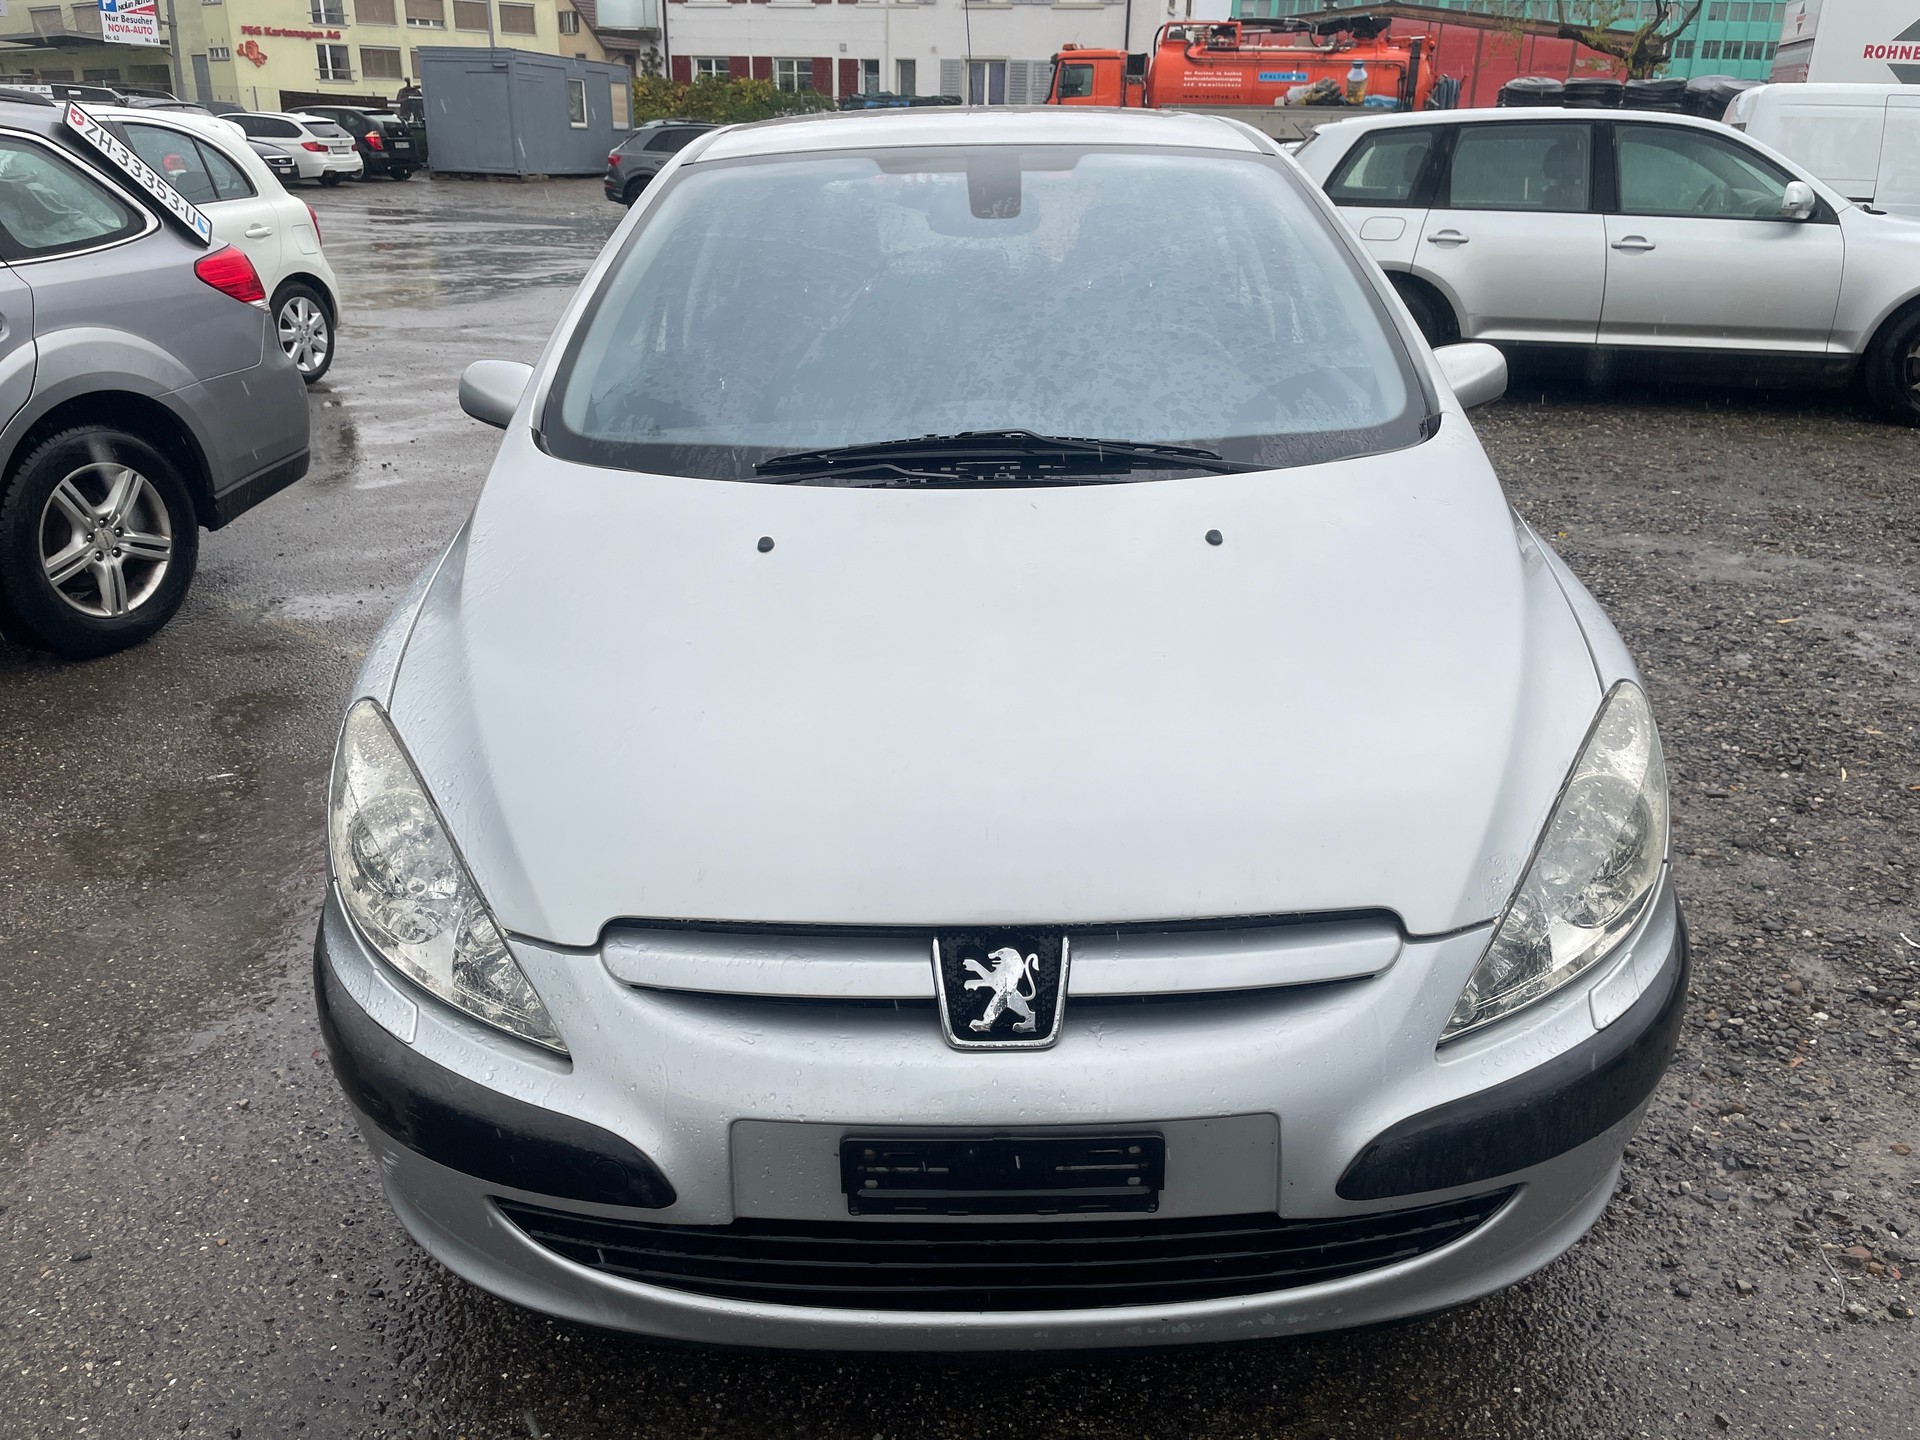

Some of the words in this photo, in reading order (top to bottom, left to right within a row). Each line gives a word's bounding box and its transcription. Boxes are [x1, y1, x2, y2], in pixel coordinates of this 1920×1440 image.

[105, 13, 118, 22] Nur
[121, 15, 153, 25] Besucher
[108, 24, 153, 35] NOVA-AUTO
